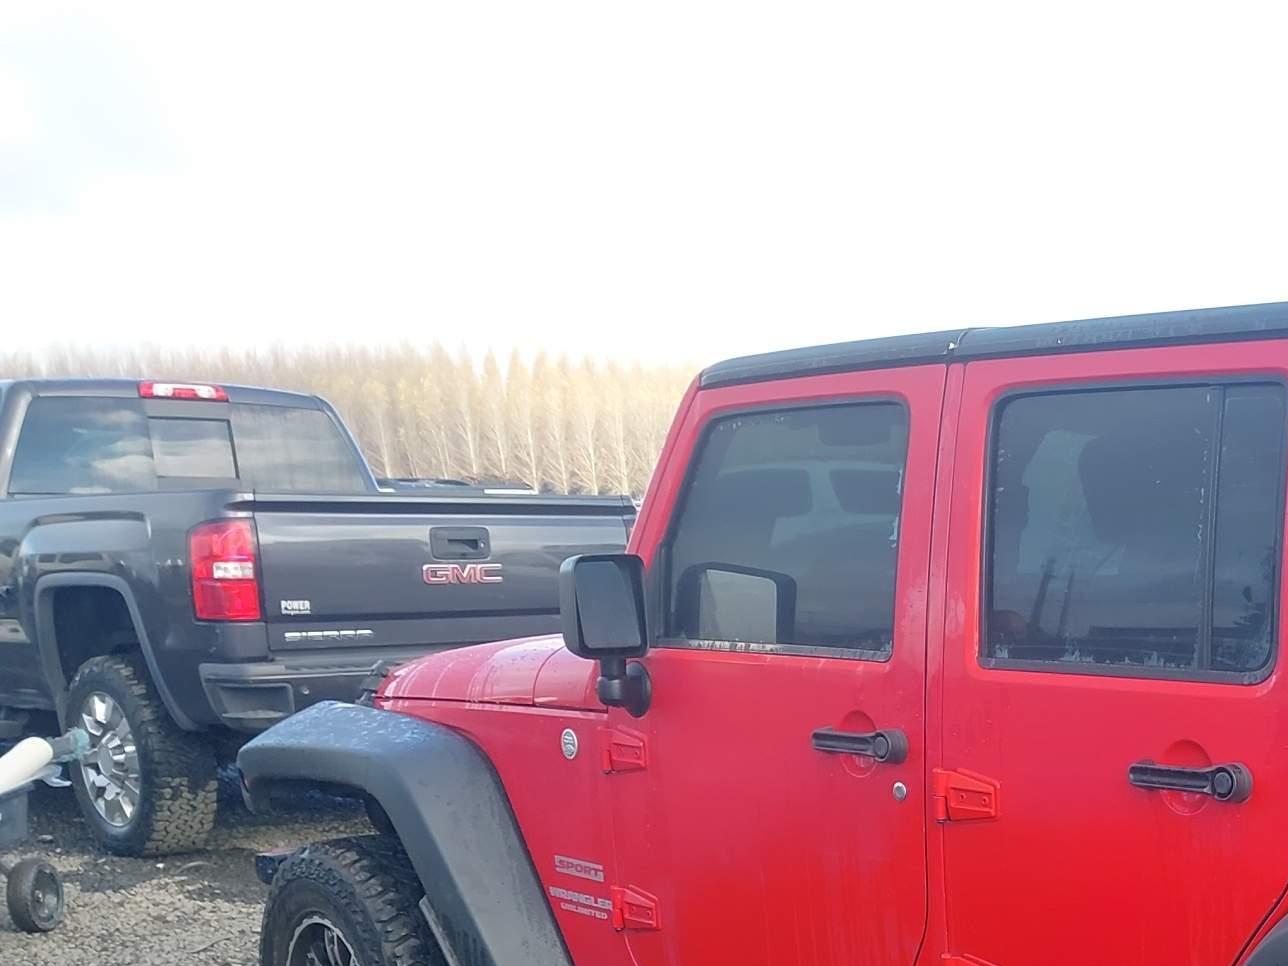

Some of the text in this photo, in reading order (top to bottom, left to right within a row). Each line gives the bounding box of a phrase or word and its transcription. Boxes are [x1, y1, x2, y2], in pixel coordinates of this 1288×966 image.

[422, 563, 503, 585] GMC
[280, 599, 311, 611] POWER
[284, 629, 374, 642] SIERRA
[554, 855, 604, 881] SPORT
